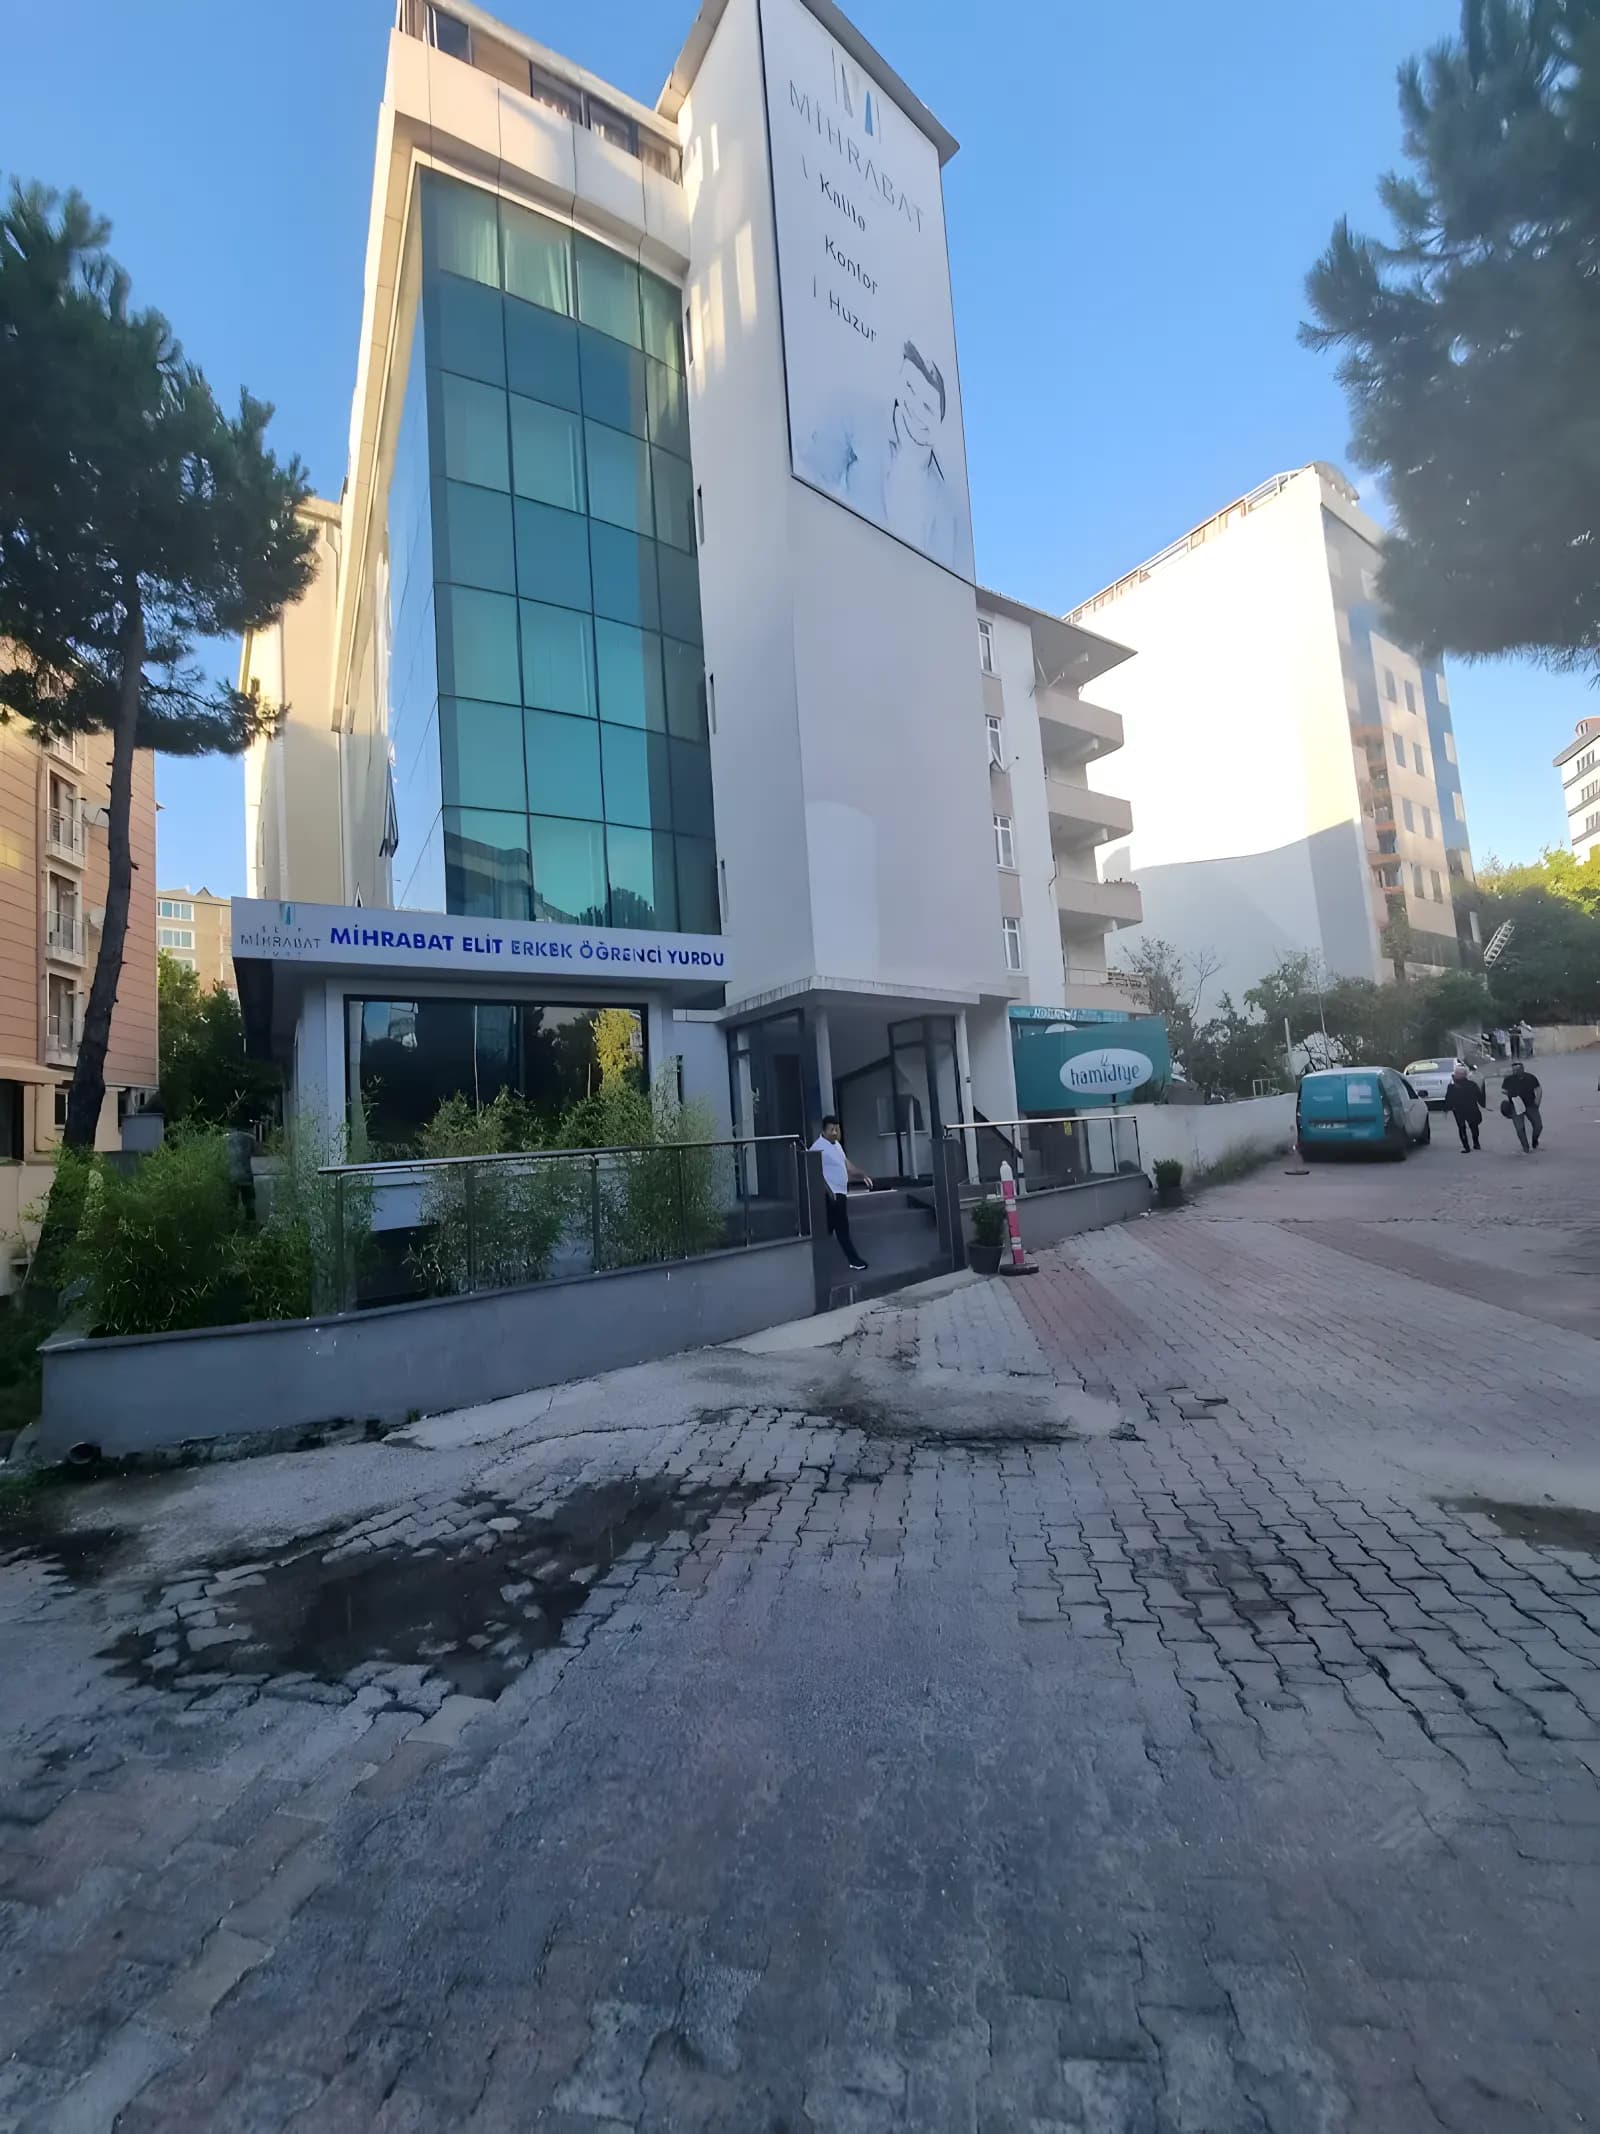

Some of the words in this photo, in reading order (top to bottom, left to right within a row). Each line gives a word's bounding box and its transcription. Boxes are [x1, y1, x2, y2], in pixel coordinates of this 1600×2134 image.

[829, 289, 877, 342] Huzur
[330, 924, 454, 951] MİHRABAT
[462, 933, 503, 954] ELİT
[511, 940, 572, 959] ERKEK
[579, 940, 662, 964] ÖĞRENCİ
[667, 949, 725, 967] YURDU
[1070, 1063, 1140, 1086] hamidiye
